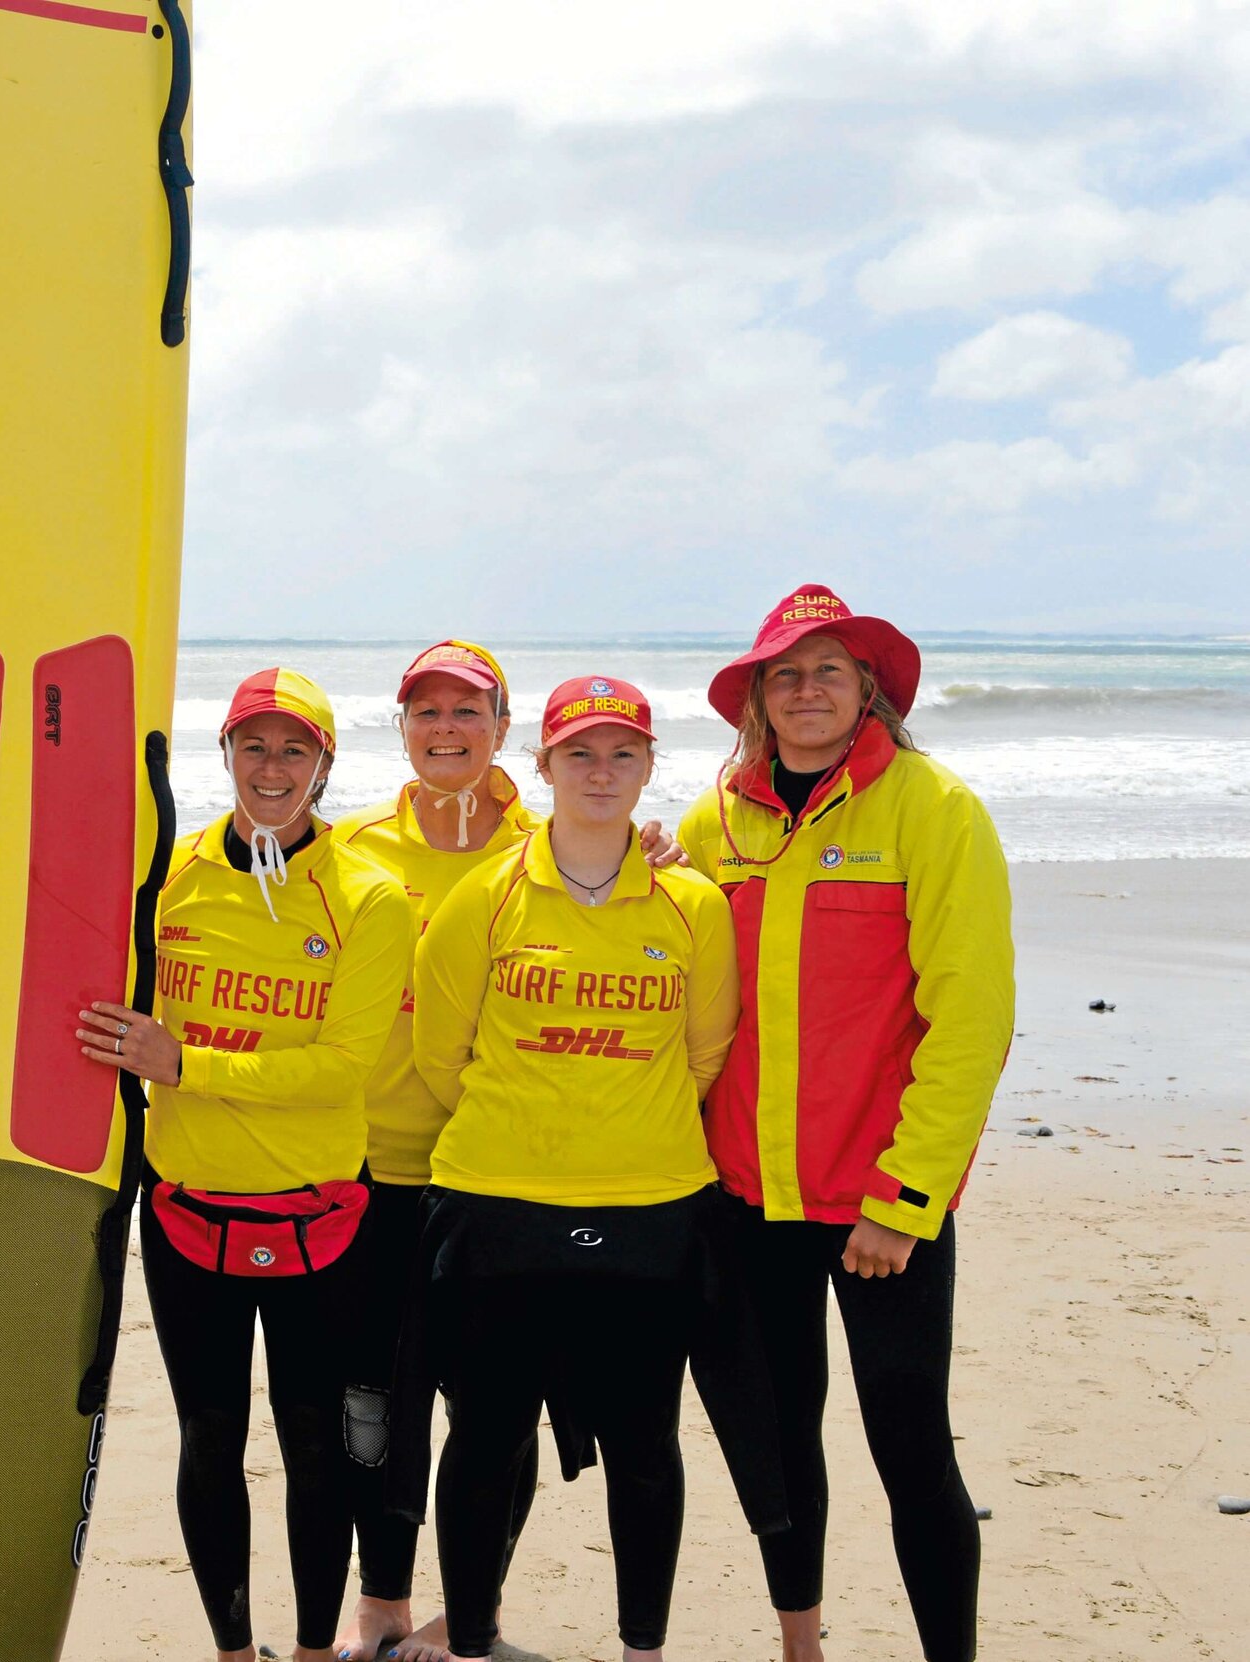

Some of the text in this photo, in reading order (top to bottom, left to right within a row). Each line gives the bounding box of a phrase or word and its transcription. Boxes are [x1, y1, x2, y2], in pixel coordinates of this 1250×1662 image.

[793, 595, 840, 608] SURF
[782, 607, 846, 623] RESCU
[561, 697, 639, 721] SURF RESCUE
[846, 855, 882, 864] TASMANIA
[161, 926, 194, 941] DHL
[211, 968, 332, 1021] RESCUE
[495, 959, 684, 1012] SURF RESCUE
[539, 1026, 630, 1060] DHL
